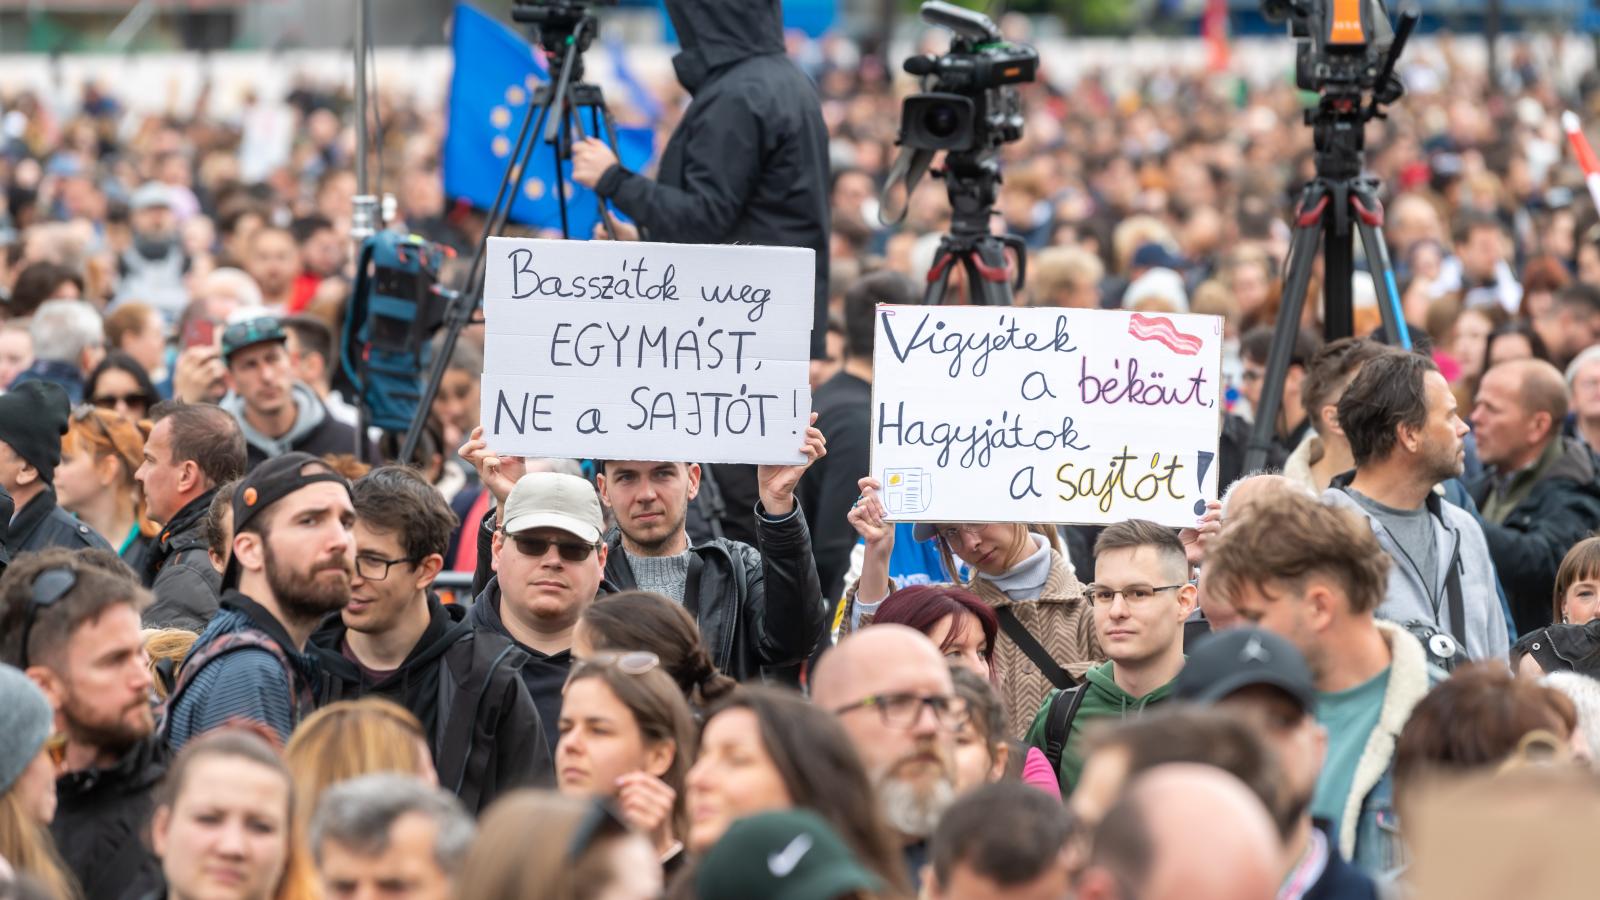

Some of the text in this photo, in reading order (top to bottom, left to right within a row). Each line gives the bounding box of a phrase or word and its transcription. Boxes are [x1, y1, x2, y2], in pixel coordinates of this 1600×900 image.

[507, 248, 680, 302] Basszátok
[550, 316, 762, 374] EGYMÁST,
[880, 311, 1078, 379] Vigyétek
[493, 389, 554, 435] NE
[576, 408, 609, 435] a
[1020, 370, 1057, 401] a
[878, 400, 1091, 469] Hagyjátok
[1009, 465, 1042, 500] a
